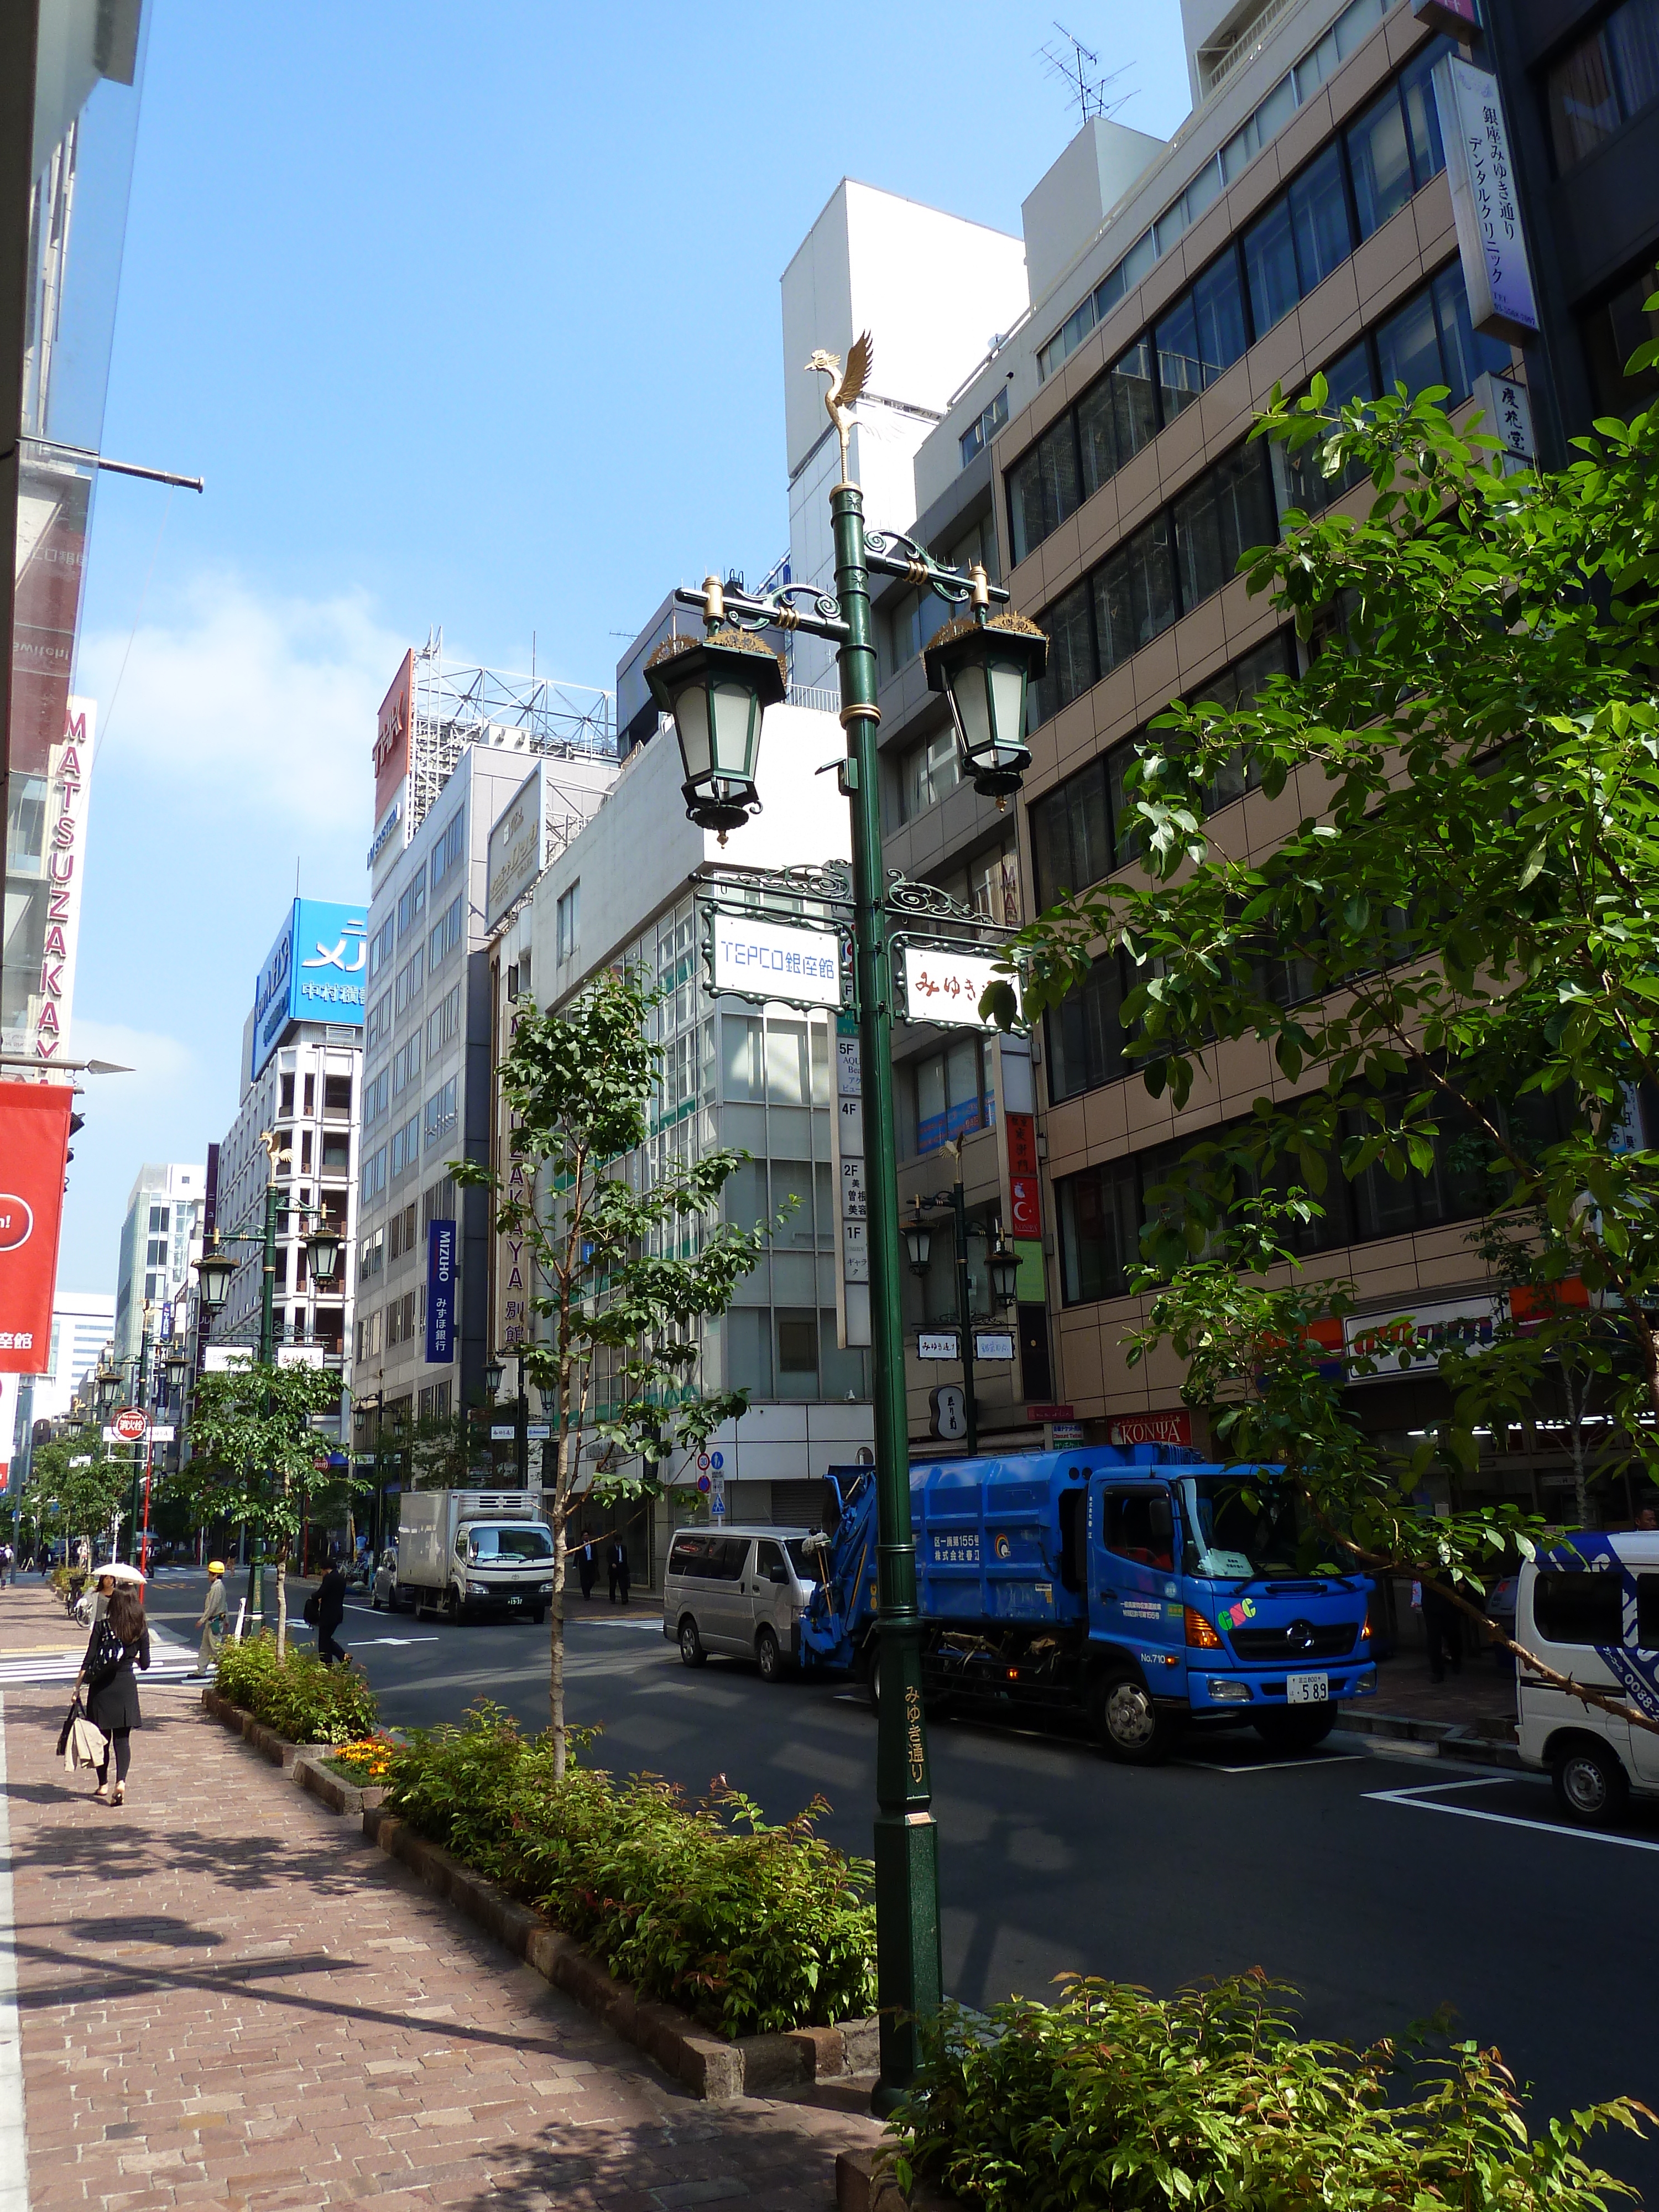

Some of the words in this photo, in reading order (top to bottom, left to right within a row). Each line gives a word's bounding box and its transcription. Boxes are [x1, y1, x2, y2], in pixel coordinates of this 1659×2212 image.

[1483, 106, 1515, 240] 銀座みゆき通り
[1469, 138, 1502, 284] デンタルクリニック
[36, 709, 86, 1085] MATSUZAKAY
[721, 941, 834, 979] TEPCO銀座館
[915, 972, 993, 1001] みゆき
[839, 1043, 854, 1055] 5F
[842, 1103, 856, 1115] 4F
[844, 1165, 858, 1177] 2F
[852, 1179, 860, 1188] 美
[848, 1204, 867, 1216] 美容
[847, 1227, 861, 1239] 1F
[439, 1230, 451, 1282] MIZUHO
[435, 1298, 447, 1351] みずほ銀行
[119, 1419, 144, 1431] 消火栓
[1141, 1653, 1165, 1663] No.710
[905, 1686, 924, 1783] みゆき通り
